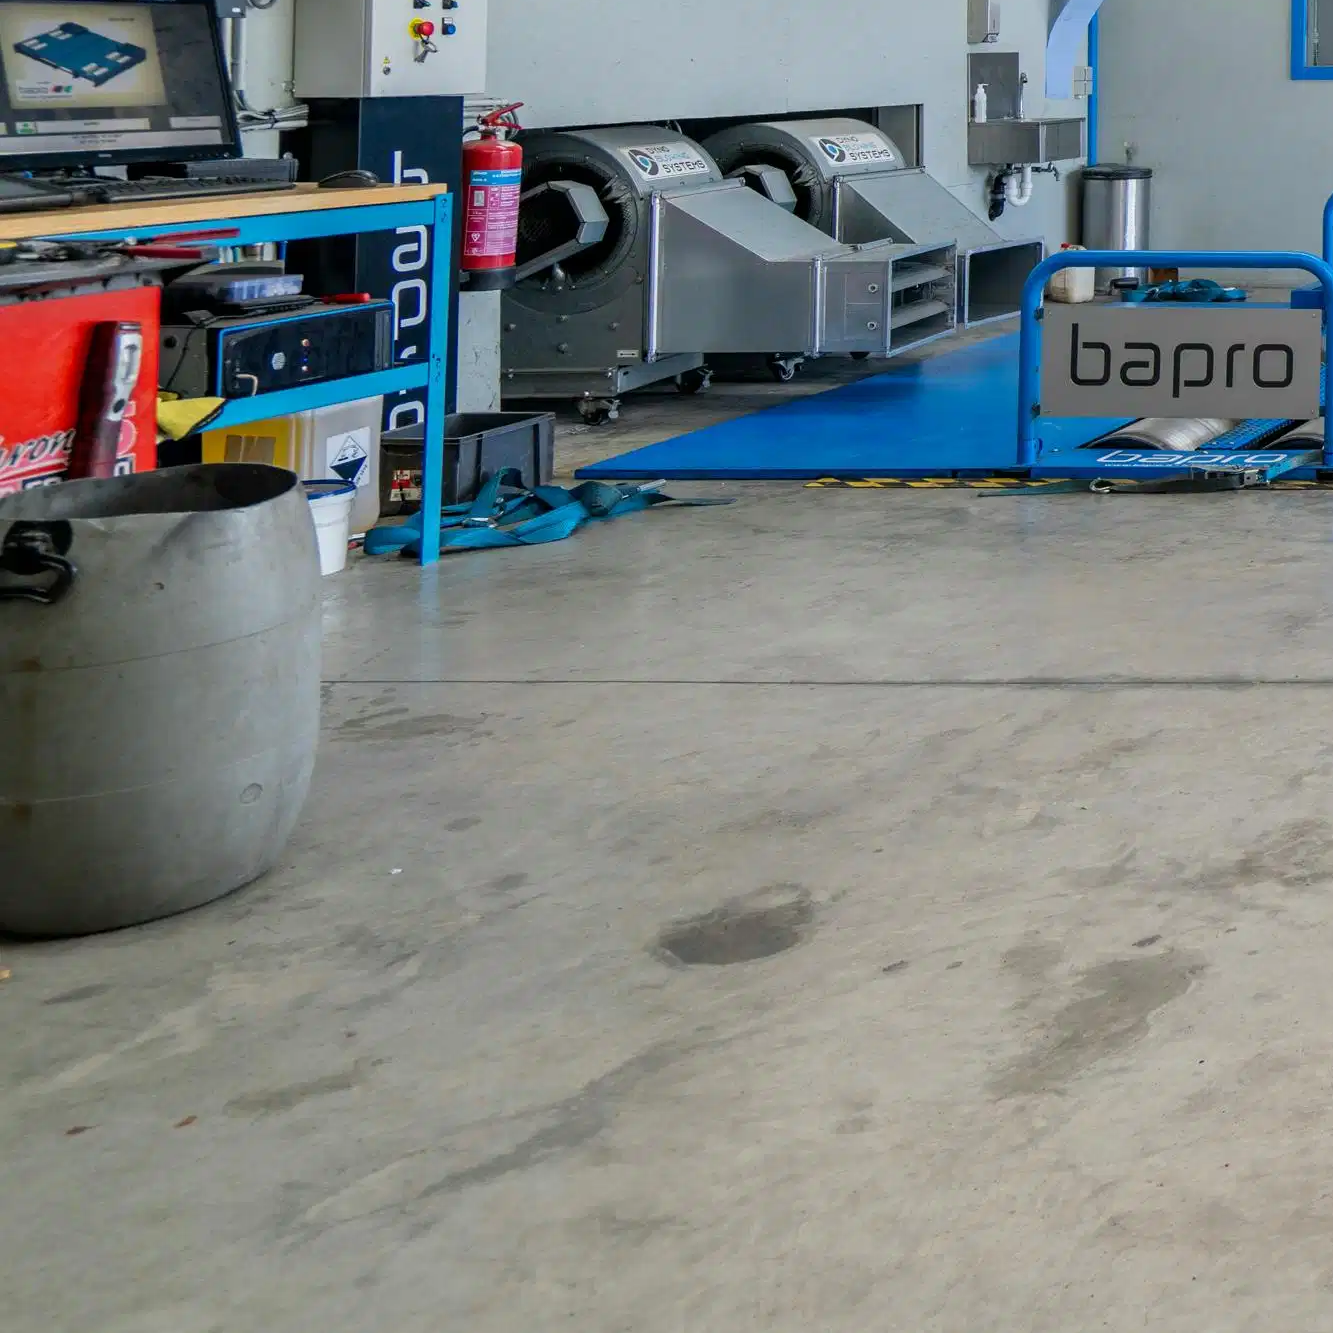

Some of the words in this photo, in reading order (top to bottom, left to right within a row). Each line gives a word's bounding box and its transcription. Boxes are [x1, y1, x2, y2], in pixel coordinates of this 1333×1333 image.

[849, 149, 891, 161] SYSTEMS
[662, 160, 706, 173] SYSTEMS
[1069, 322, 1294, 399] bapro
[1096, 450, 1288, 465] bapro
